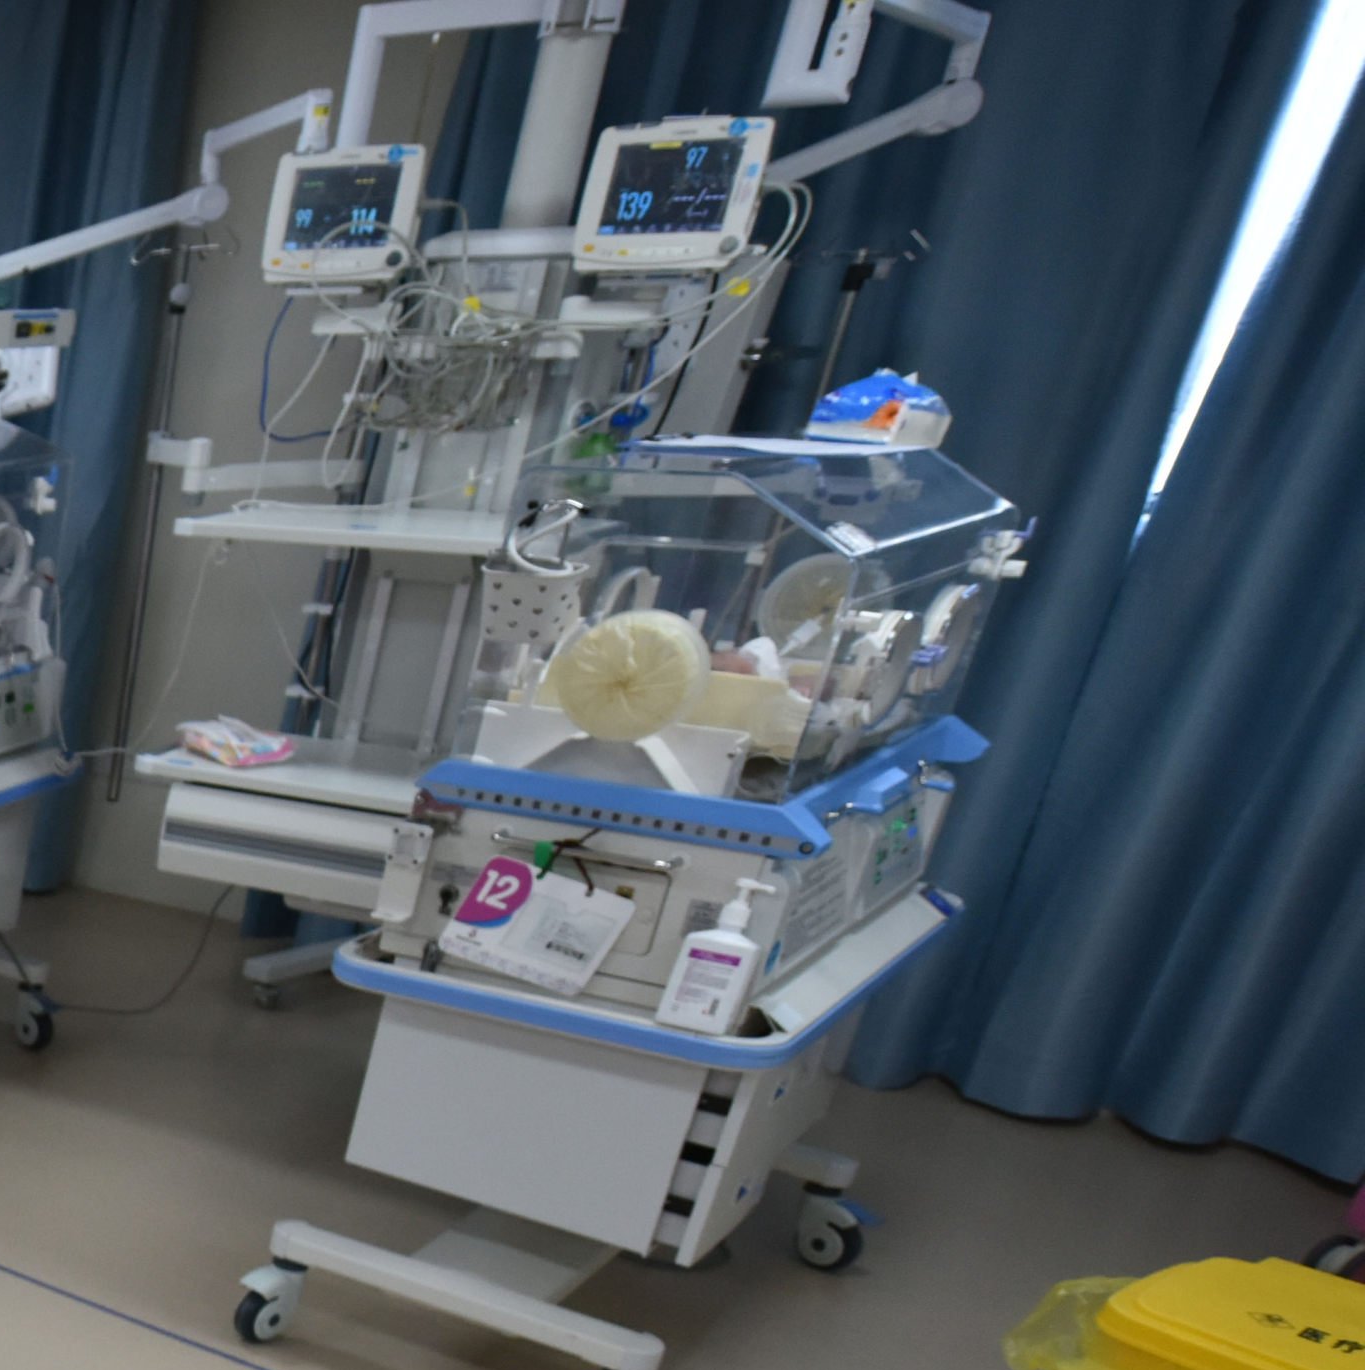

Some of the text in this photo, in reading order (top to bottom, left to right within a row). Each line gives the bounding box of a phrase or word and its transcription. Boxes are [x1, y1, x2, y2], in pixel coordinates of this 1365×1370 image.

[685, 146, 709, 169] 97
[616, 191, 654, 221] 139
[475, 869, 521, 911] 12
